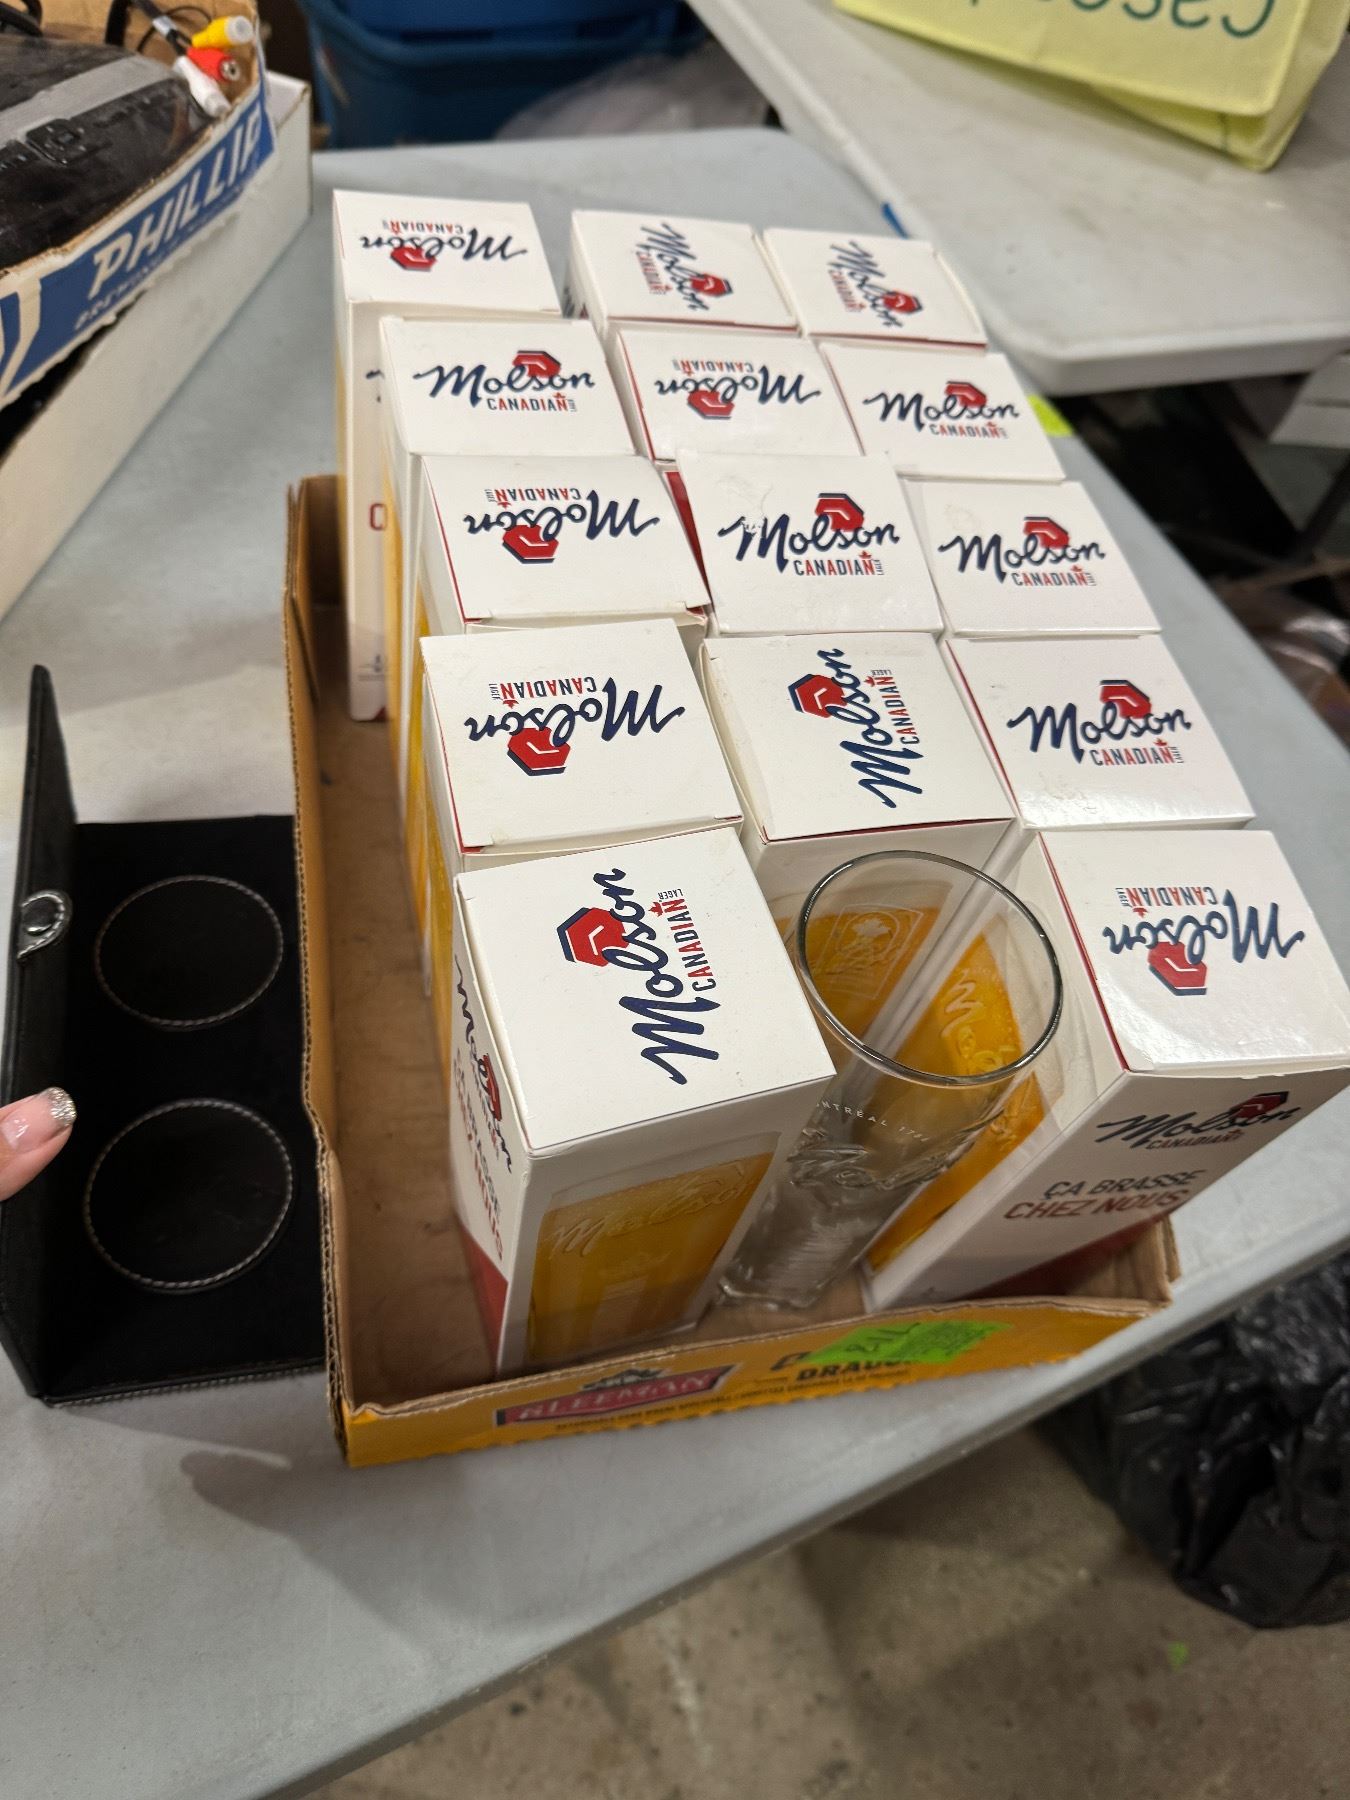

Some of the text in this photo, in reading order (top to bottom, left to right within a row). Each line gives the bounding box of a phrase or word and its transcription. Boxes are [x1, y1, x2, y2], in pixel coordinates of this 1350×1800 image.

[359, 227, 530, 262] Molson
[389, 219, 464, 235] CANADIAN
[636, 222, 710, 312] Molson
[827, 240, 903, 328] Molson
[413, 364, 596, 409] Molson
[654, 364, 821, 406] Molson
[680, 358, 755, 374] CANADIAN
[487, 397, 568, 413] CANADIAN
[862, 391, 1020, 432] Molson
[928, 423, 1001, 439] CANADIAN
[463, 489, 661, 541] Molson
[494, 487, 581, 503] CANADIAN
[716, 512, 900, 574] Molson
[936, 532, 1107, 584] Molson
[792, 558, 875, 577] CANADIAN
[1010, 571, 1088, 587] CANADIAN
[499, 676, 598, 700] CANADIAN
[463, 676, 686, 742] Molson
[816, 647, 925, 809] Molson
[877, 675, 921, 746] CANADIAN
[1005, 702, 1192, 765] Molson
[1088, 744, 1173, 767] CANADIAN
[1124, 886, 1218, 908] CANADIAN
[657, 888, 718, 993] CANADIAN LAGER
[1101, 888, 1306, 964] Molson
[592, 867, 721, 1086] Molson
[1094, 1106, 1302, 1150] Molson
[1145, 1128, 1245, 1151] CANADIAN
[1091, 1168, 1209, 1198] BRASSE
[1002, 1187, 1192, 1221] CHEZ NOUS
